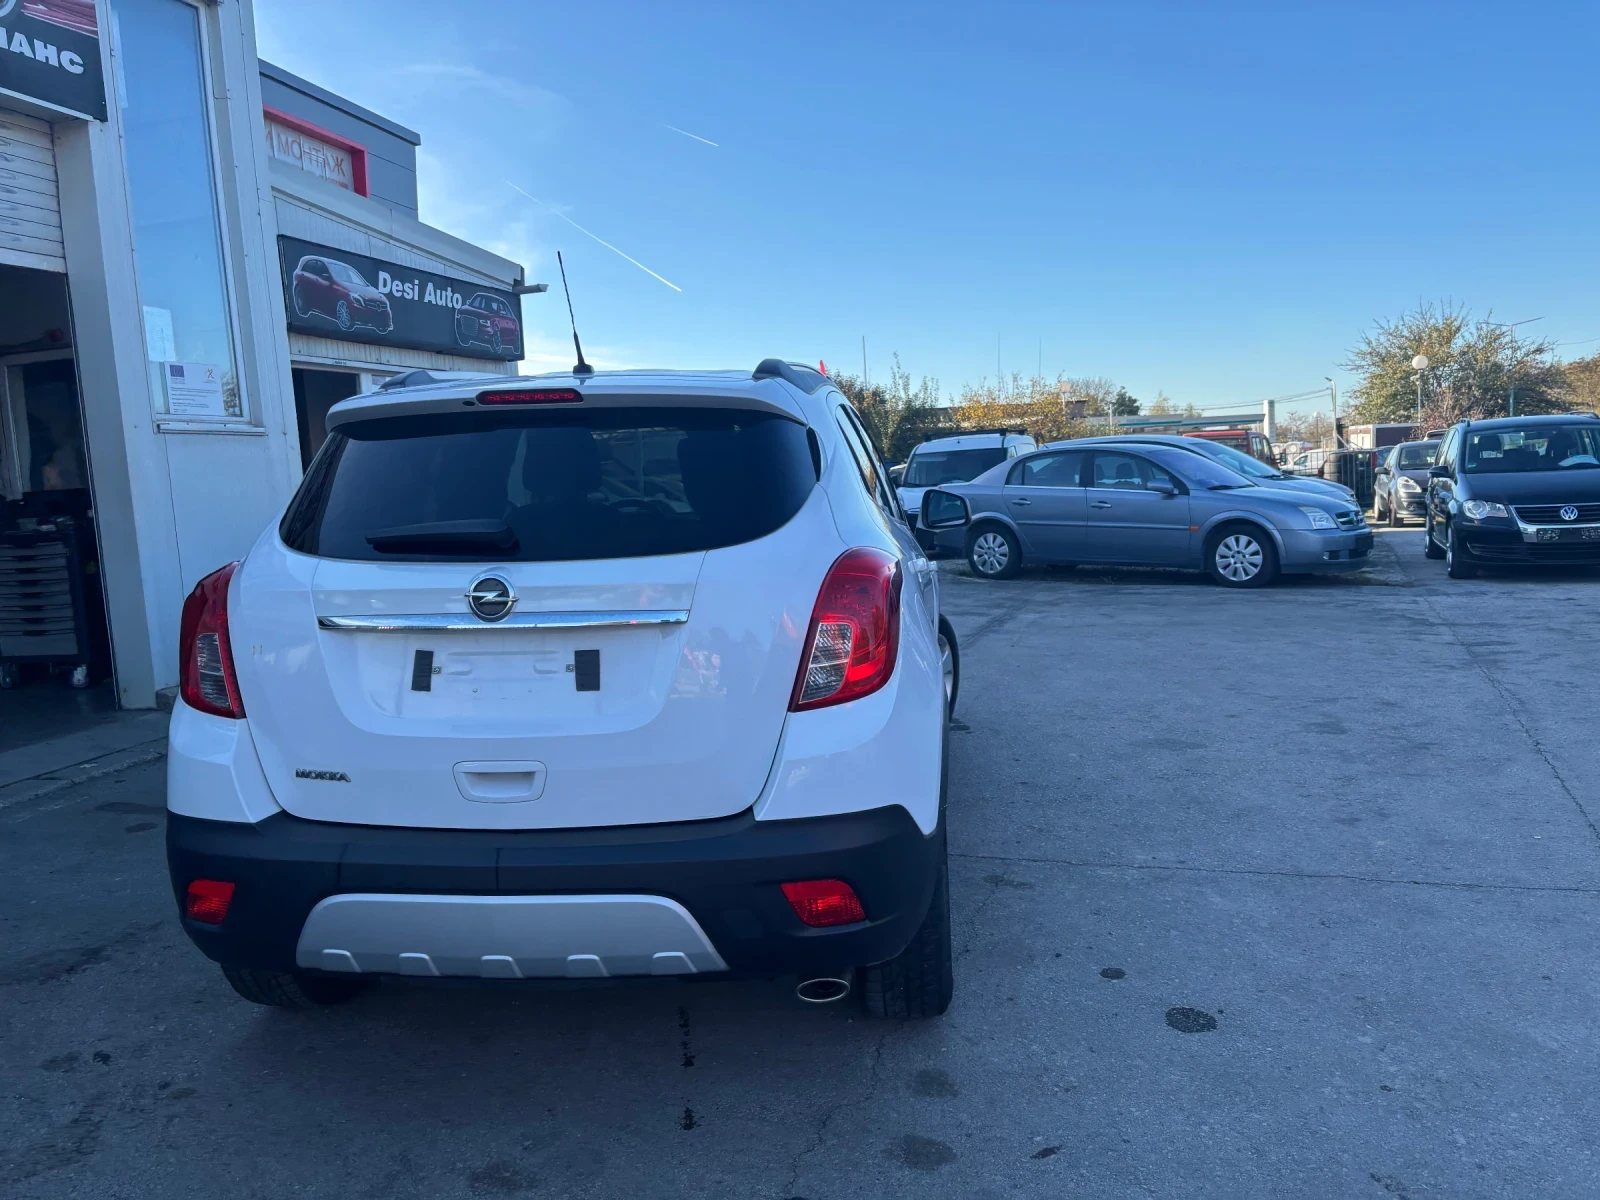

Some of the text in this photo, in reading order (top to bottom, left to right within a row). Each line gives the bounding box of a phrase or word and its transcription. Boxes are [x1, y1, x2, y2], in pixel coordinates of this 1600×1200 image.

[378, 270, 463, 309] Desi Auto
[295, 768, 352, 783] MOKKA
